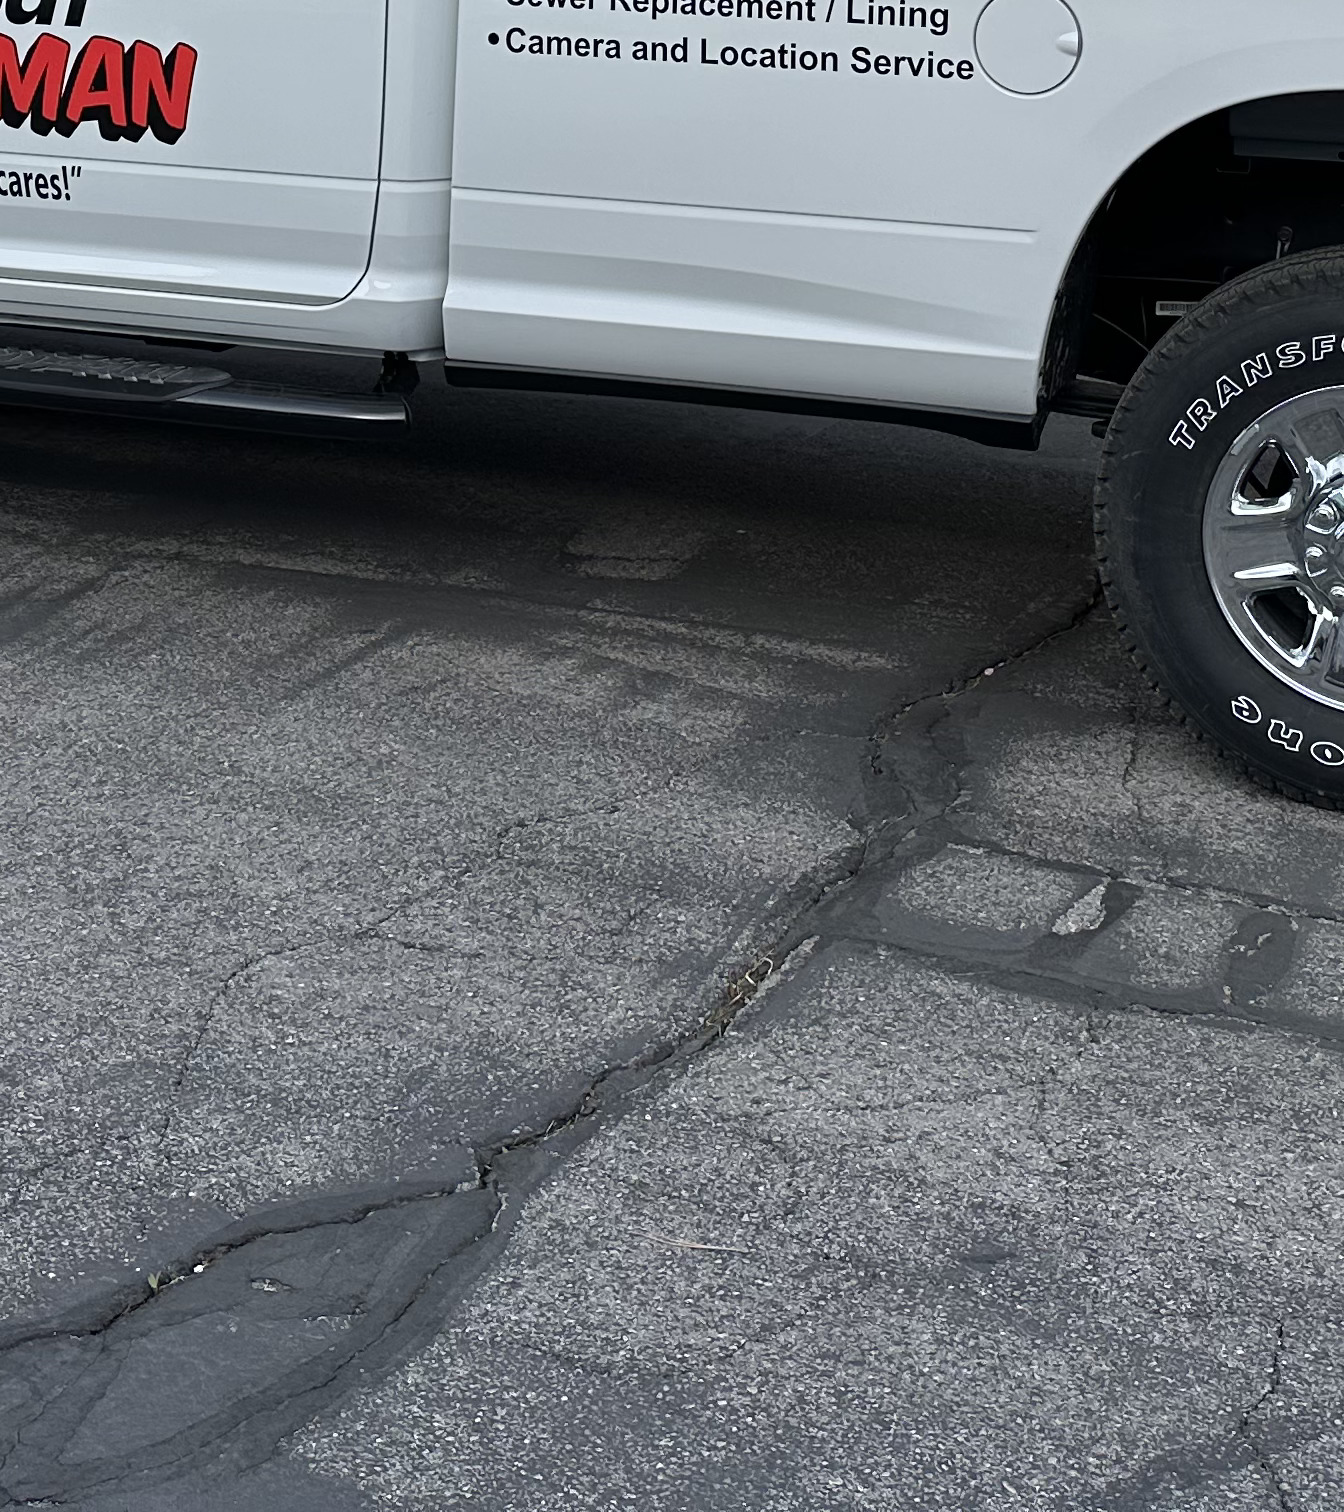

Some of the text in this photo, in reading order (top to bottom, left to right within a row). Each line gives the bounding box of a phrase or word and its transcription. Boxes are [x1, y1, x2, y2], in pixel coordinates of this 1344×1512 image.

[505, 28, 975, 80] Camera and Location Service
